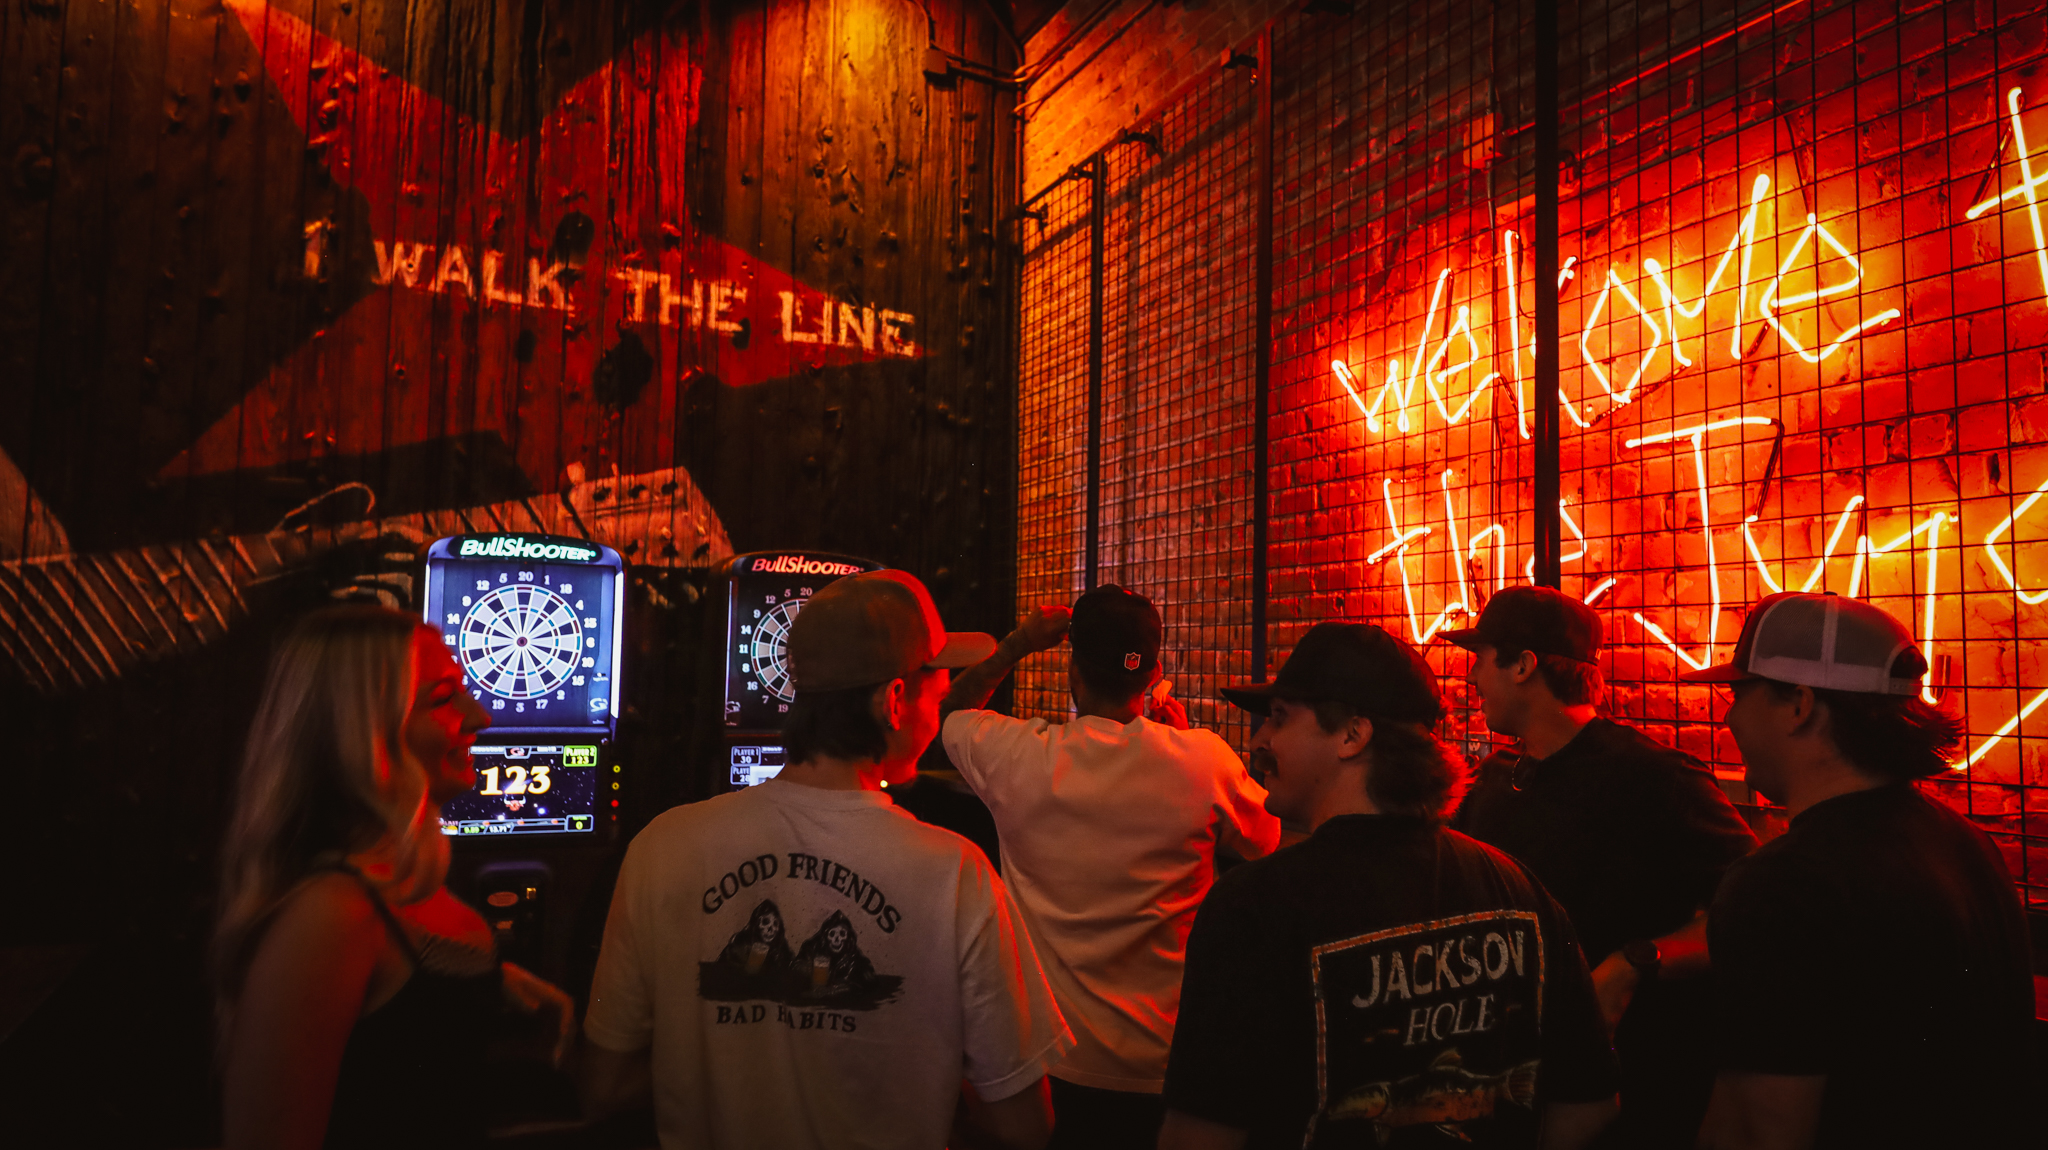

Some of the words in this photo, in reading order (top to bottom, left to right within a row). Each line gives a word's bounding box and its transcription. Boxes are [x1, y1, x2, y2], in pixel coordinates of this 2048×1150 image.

[373, 240, 580, 320] WALK
[613, 266, 750, 334] THE
[778, 289, 918, 357] LINE
[518, 571, 534, 582] 20
[544, 575, 550, 585] 1
[476, 580, 490, 591] 12
[784, 588, 791, 598] 5
[800, 587, 813, 597] 20
[462, 596, 472, 607] 9
[765, 594, 776, 605] 12
[575, 600, 584, 611] 4
[447, 613, 460, 625] 14
[753, 609, 761, 619] 9
[740, 625, 752, 635] 14
[445, 635, 456, 646] 11
[738, 644, 749, 654] 11
[582, 656, 595, 668] 10
[742, 663, 750, 673] 8
[747, 681, 758, 691] 16
[473, 690, 482, 700] 7
[762, 695, 769, 704] 7
[492, 699, 505, 710] 19
[536, 699, 549, 710] 17
[777, 703, 789, 713] 19
[566, 748, 589, 756] PLAYER
[590, 748, 595, 756] 2
[733, 748, 755, 756] PLAYER
[571, 756, 589, 764] 123
[740, 755, 752, 764] 30
[732, 767, 750, 775] PLAYE
[480, 765, 551, 795] 123
[701, 853, 779, 915] GOOD
[786, 852, 902, 934] FRIENDS
[1352, 929, 1526, 1009] JACKSON
[716, 1004, 766, 1025] BAD
[777, 1005, 857, 1033] HABITS
[1402, 993, 1497, 1047] HOLE
